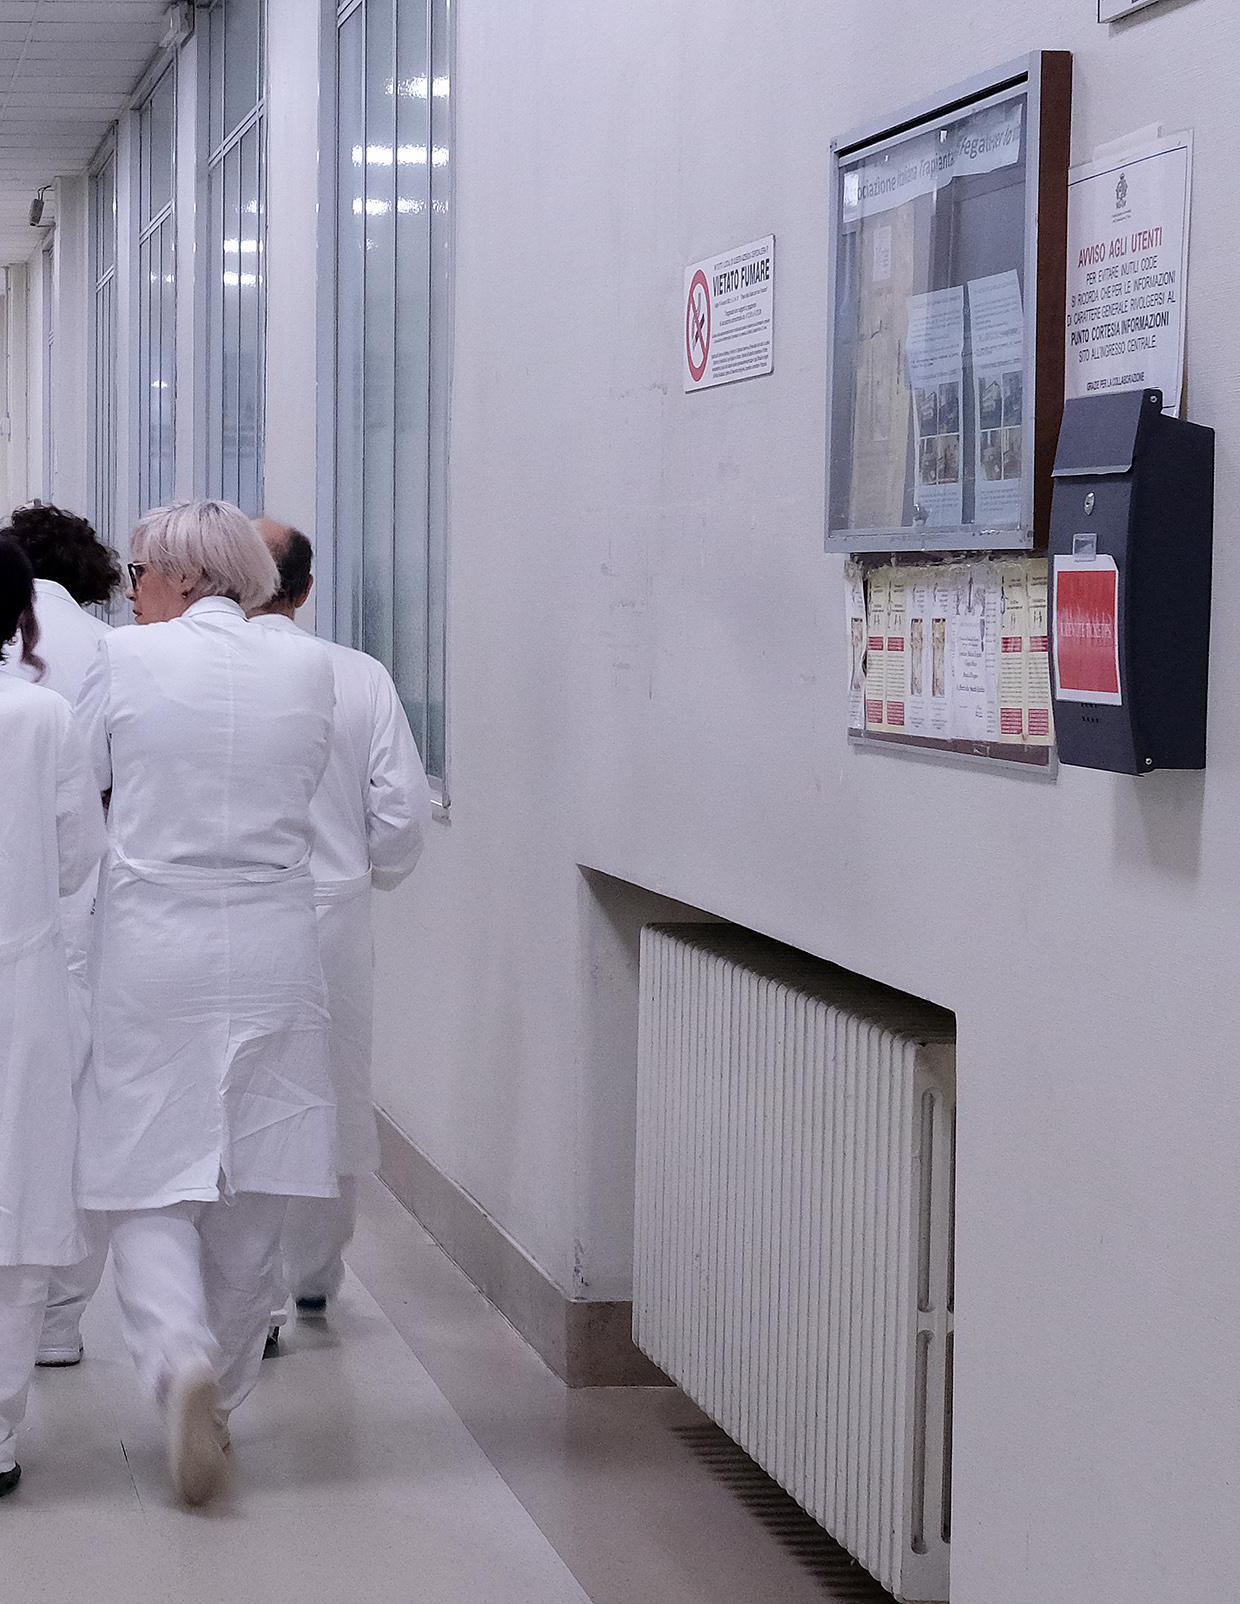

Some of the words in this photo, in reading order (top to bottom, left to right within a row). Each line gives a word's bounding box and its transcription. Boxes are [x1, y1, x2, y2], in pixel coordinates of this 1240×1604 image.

[857, 179, 897, 201] ociazione
[1078, 243, 1106, 268] AVVISO
[1109, 237, 1127, 259] AGLI
[1131, 226, 1163, 253] UTENTI
[713, 269, 739, 297] VIETATO
[740, 258, 770, 289] FUMARE
[1086, 271, 1096, 285] PER
[1098, 265, 1119, 283] EVITARE
[1121, 260, 1139, 276] INUTILI
[1141, 255, 1158, 272] CODE
[1071, 295, 1076, 308] SI
[1077, 289, 1099, 306] RICORDA
[1100, 285, 1111, 300] CHE
[1112, 282, 1122, 297] PER
[1124, 280, 1131, 294] LE
[1133, 270, 1176, 292] INFORMAZIONI
[1073, 306, 1101, 325] CARATTERE
[1102, 299, 1128, 318] GENERALE
[1130, 292, 1165, 311] RIVOLGERSI
[1167, 290, 1176, 303] AL
[1071, 328, 1089, 346] PUNTO
[1091, 322, 1120, 341] CORTESIA
[1121, 311, 1170, 335] INFORMAZIONI
[1078, 349, 1090, 363] SITO
[1127, 335, 1157, 353] CENTRALE
